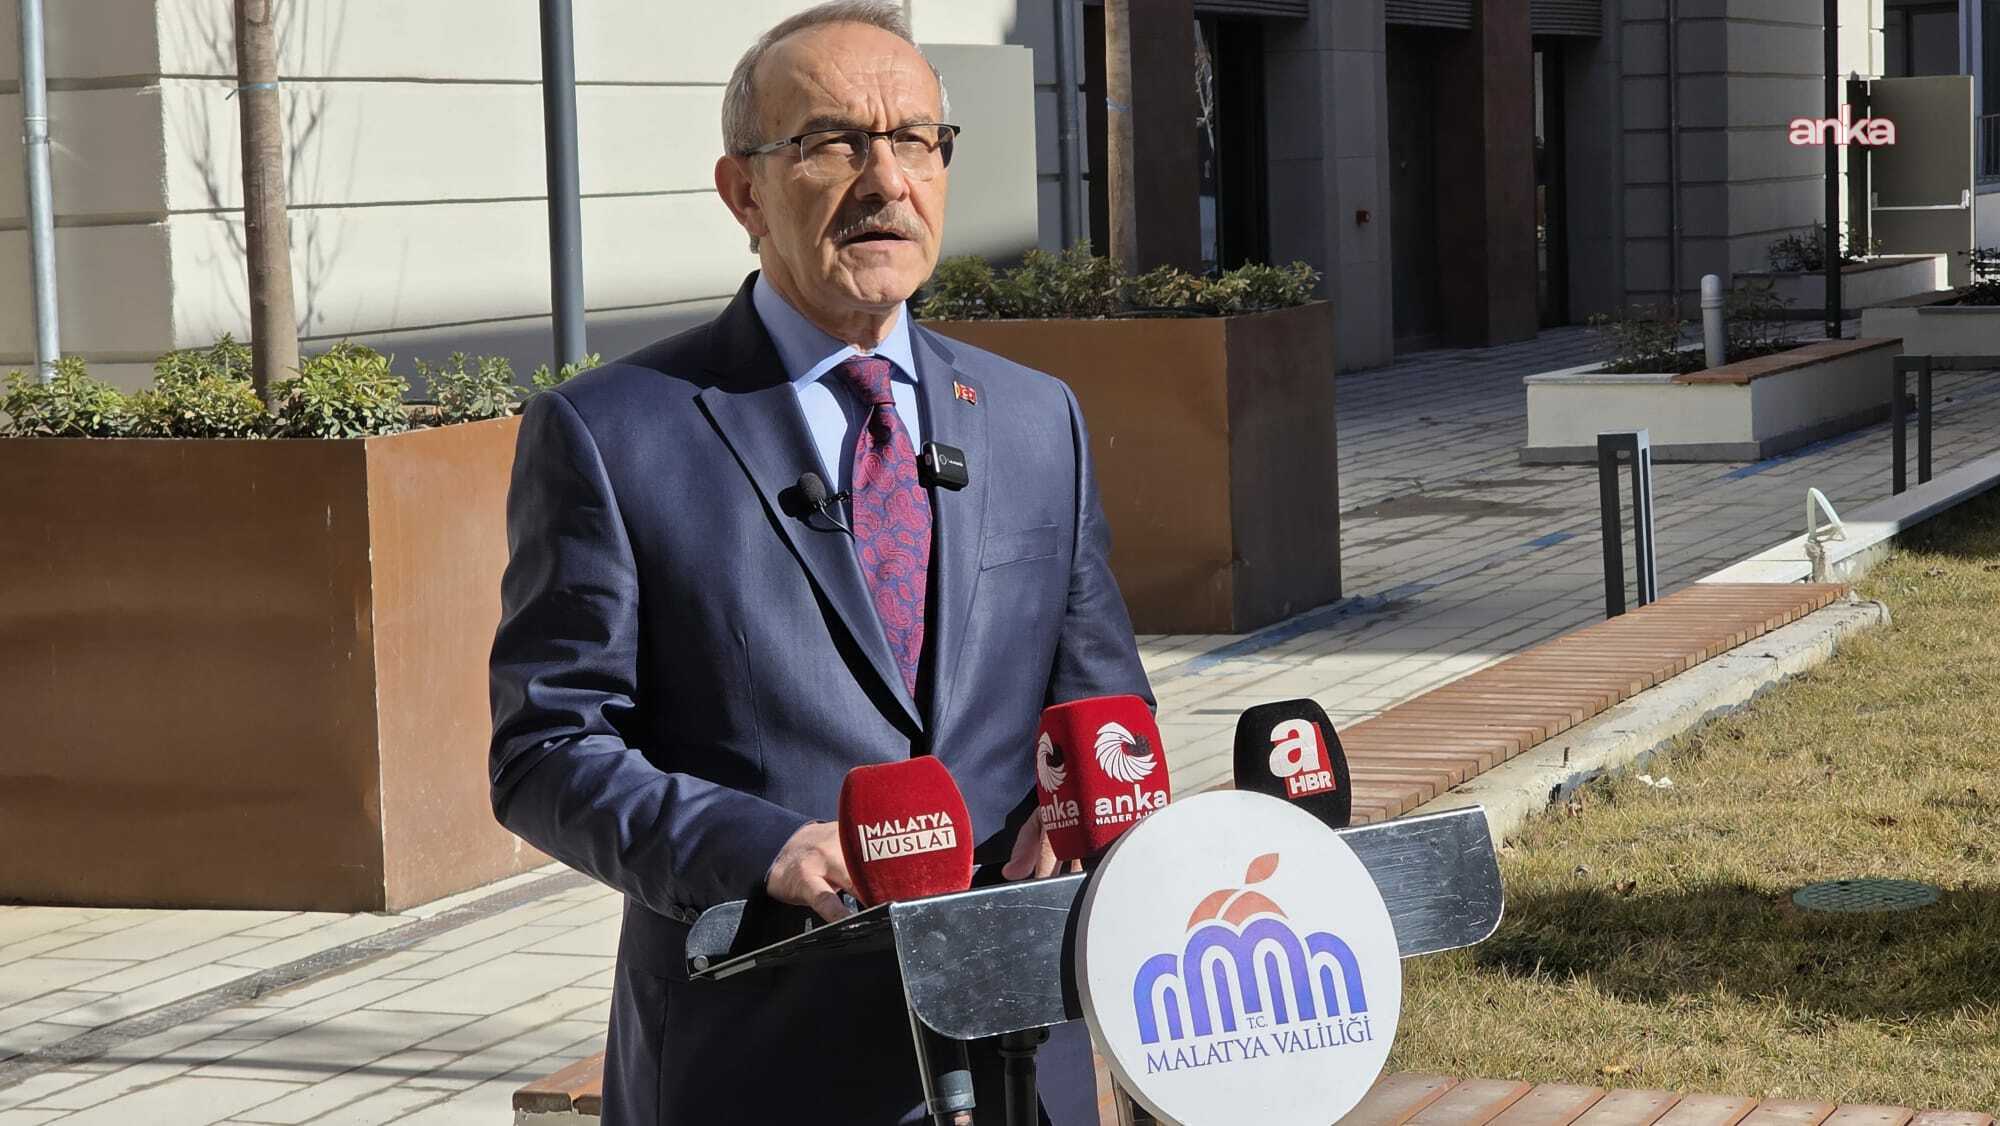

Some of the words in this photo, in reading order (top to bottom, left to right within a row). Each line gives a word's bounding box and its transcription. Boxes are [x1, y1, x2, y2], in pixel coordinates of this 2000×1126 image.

[1269, 719, 1321, 777] a
[1289, 770, 1333, 794] HBR
[1041, 794, 1080, 822] anka
[1095, 784, 1168, 816] anka
[865, 811, 953, 838] MALATYA
[1095, 813, 1132, 825] HABER
[871, 830, 952, 857] VUSLAT
[1246, 1015, 1269, 1030] T.C.
[1147, 1037, 1270, 1074] MALATYA
[1272, 1015, 1374, 1054] VALİLİĞİ
